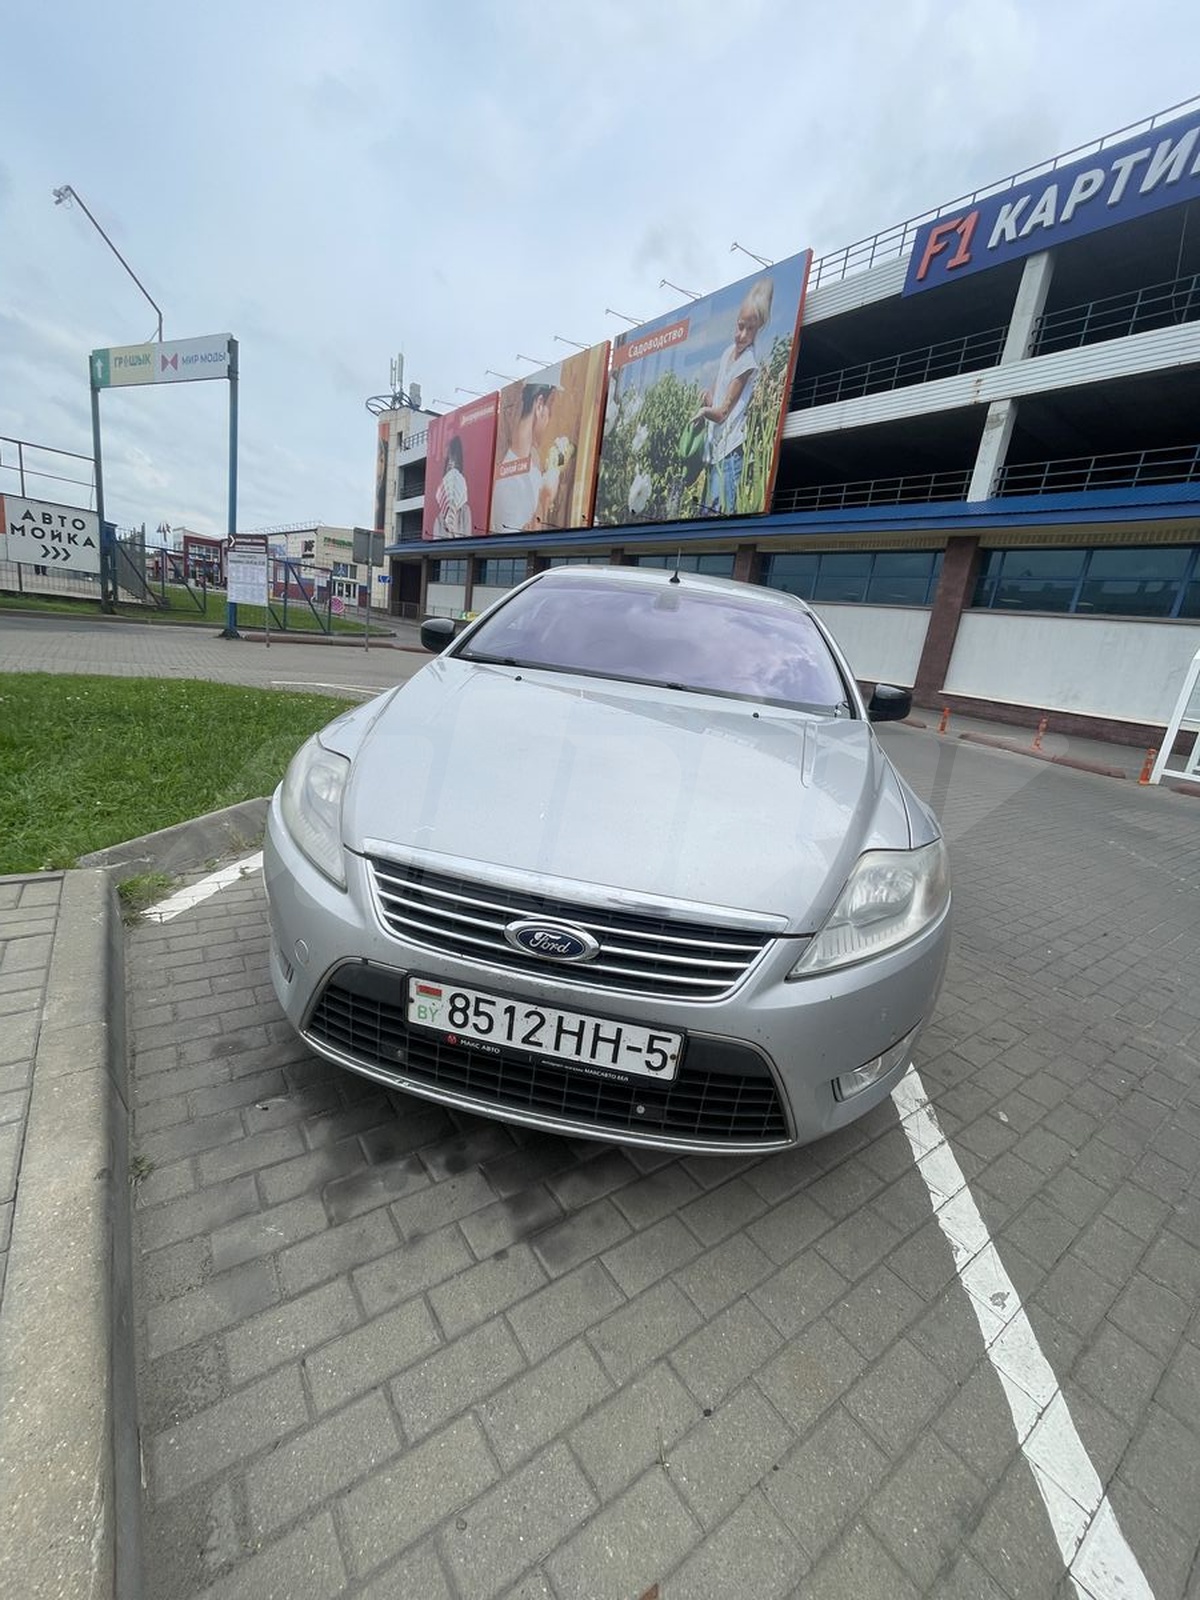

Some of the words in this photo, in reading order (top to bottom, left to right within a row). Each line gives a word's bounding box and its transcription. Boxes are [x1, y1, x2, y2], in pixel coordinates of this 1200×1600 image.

[916, 209, 980, 282] F1
[627, 325, 685, 358] Садоводство
[182, 354, 199, 366] МИР
[200, 351, 227, 364] МОДЫ
[22, 509, 86, 531] АВТО
[10, 522, 96, 549] МОЙКА
[529, 932, 570, 955] Ford
[417, 1006, 440, 1023] BY
